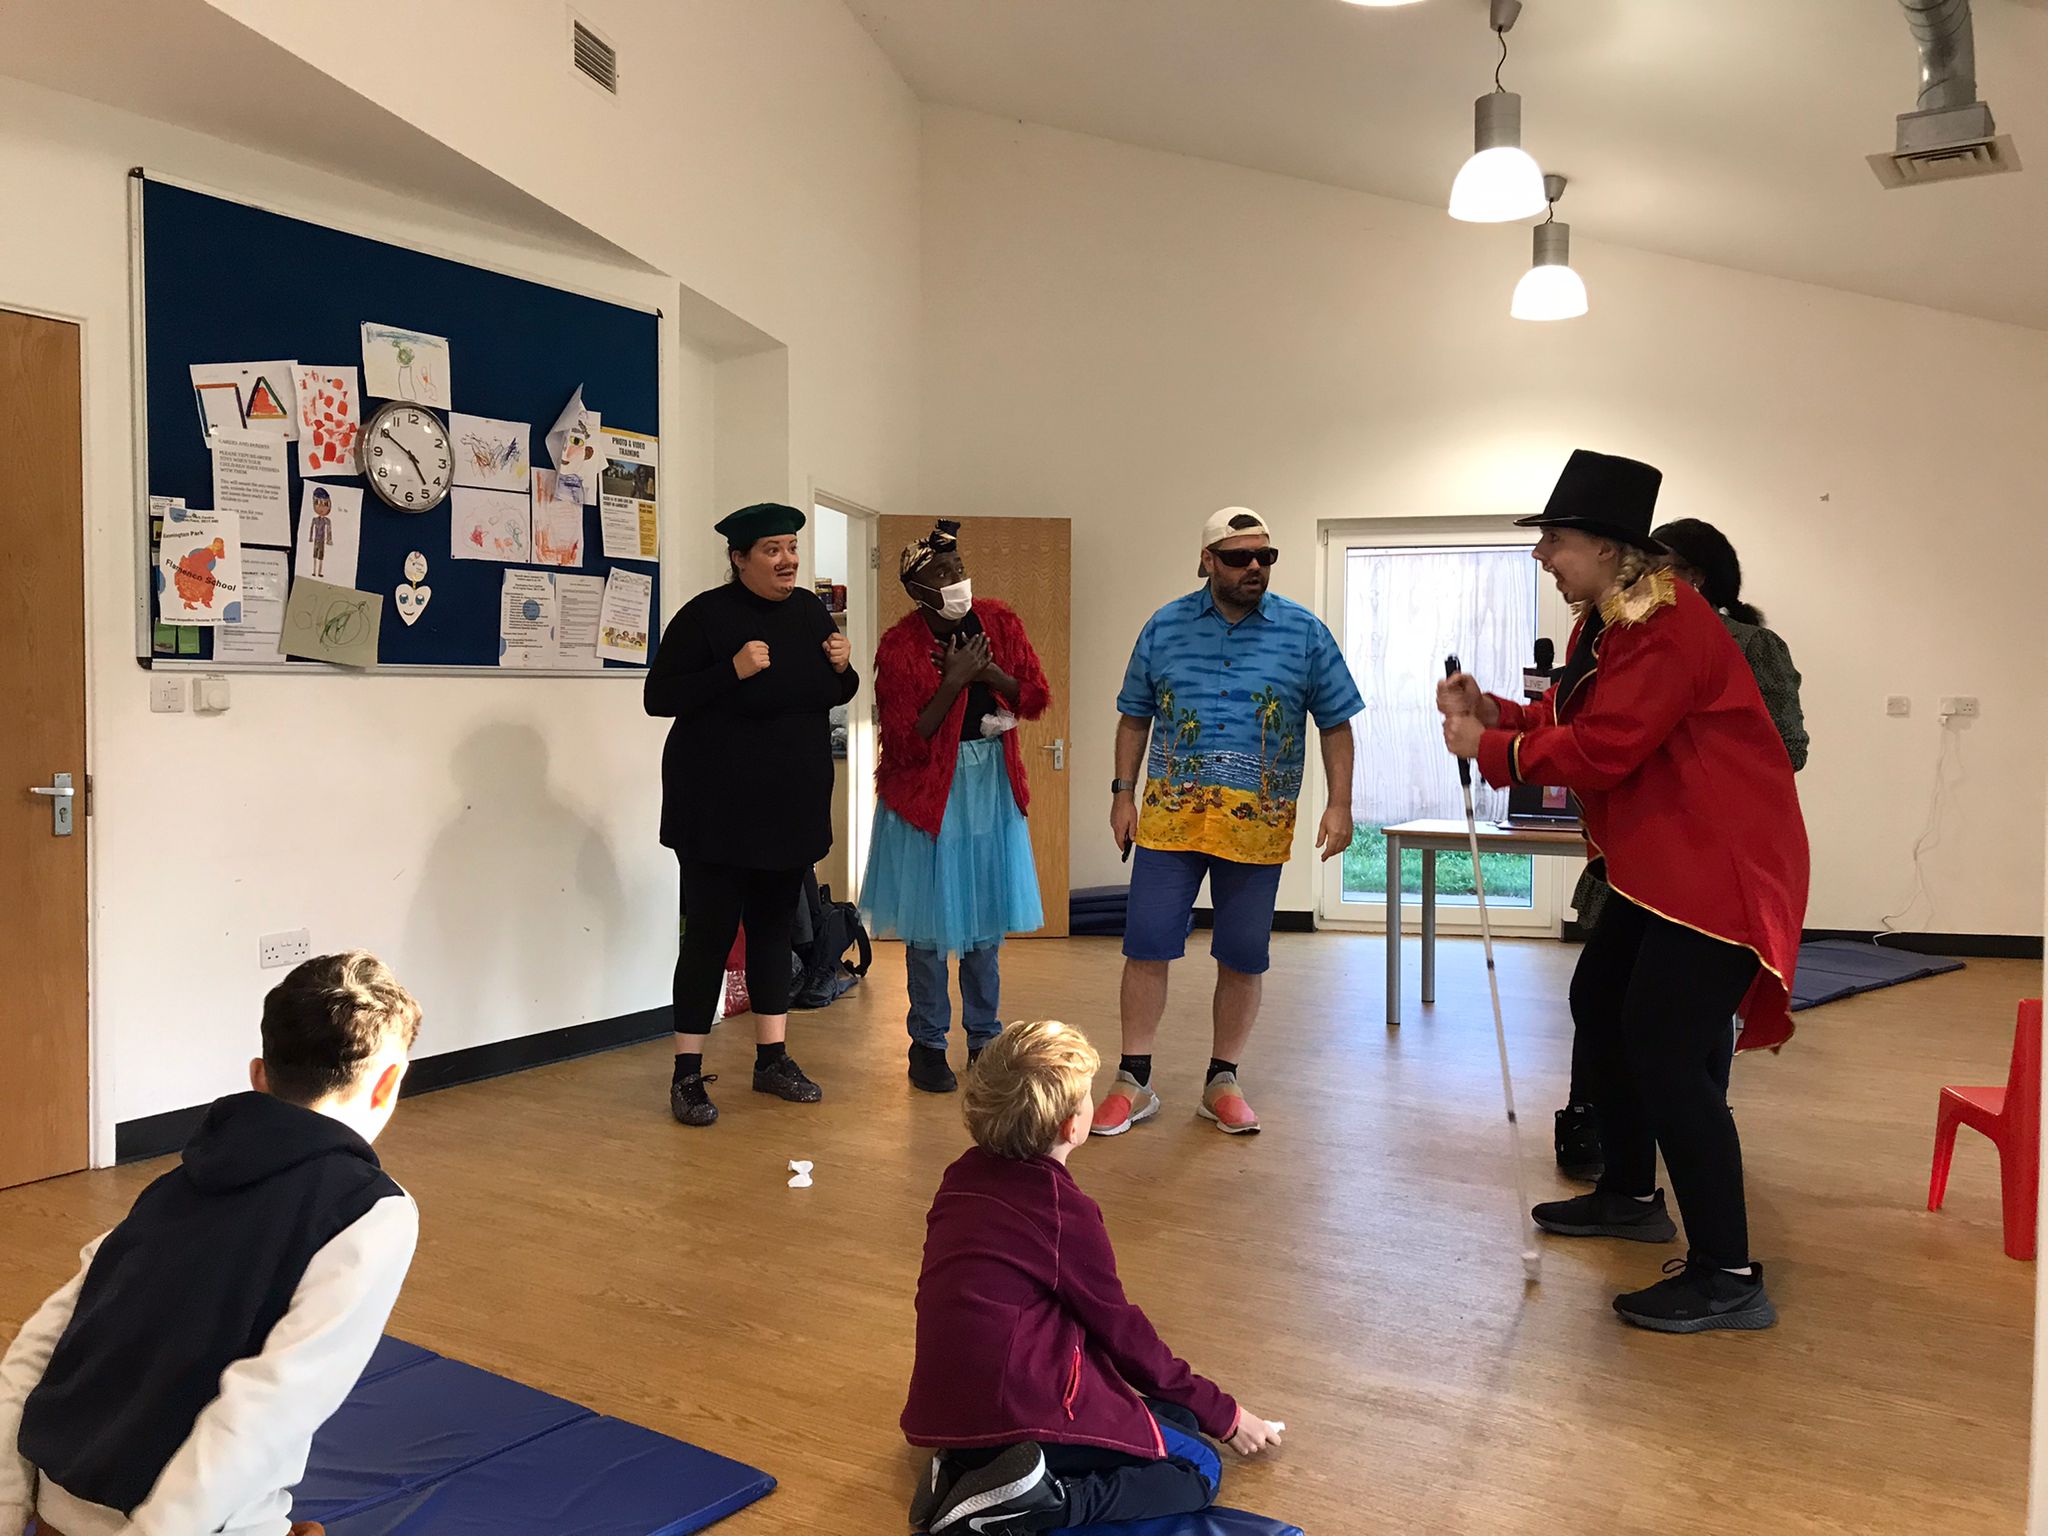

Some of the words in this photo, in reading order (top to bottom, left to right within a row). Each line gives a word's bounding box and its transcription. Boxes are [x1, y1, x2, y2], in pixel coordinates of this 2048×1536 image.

[393, 417, 400, 427] 11
[408, 413, 419, 425] 12
[380, 428, 390, 438] 10
[434, 439, 443, 449] 2
[612, 437, 627, 447] PHOTO
[632, 440, 645, 450] VIDEO
[373, 446, 383, 456] 9
[619, 447, 640, 458] TRAINING
[438, 459, 447, 469] 3
[378, 467, 388, 477] 8
[433, 477, 441, 486] 4
[390, 484, 398, 494] 7
[421, 489, 430, 499] 5
[405, 492, 414, 502] 6
[165, 558, 203, 581] Flamenco
[205, 576, 236, 592] School
[1524, 680, 1544, 689] LIVE
